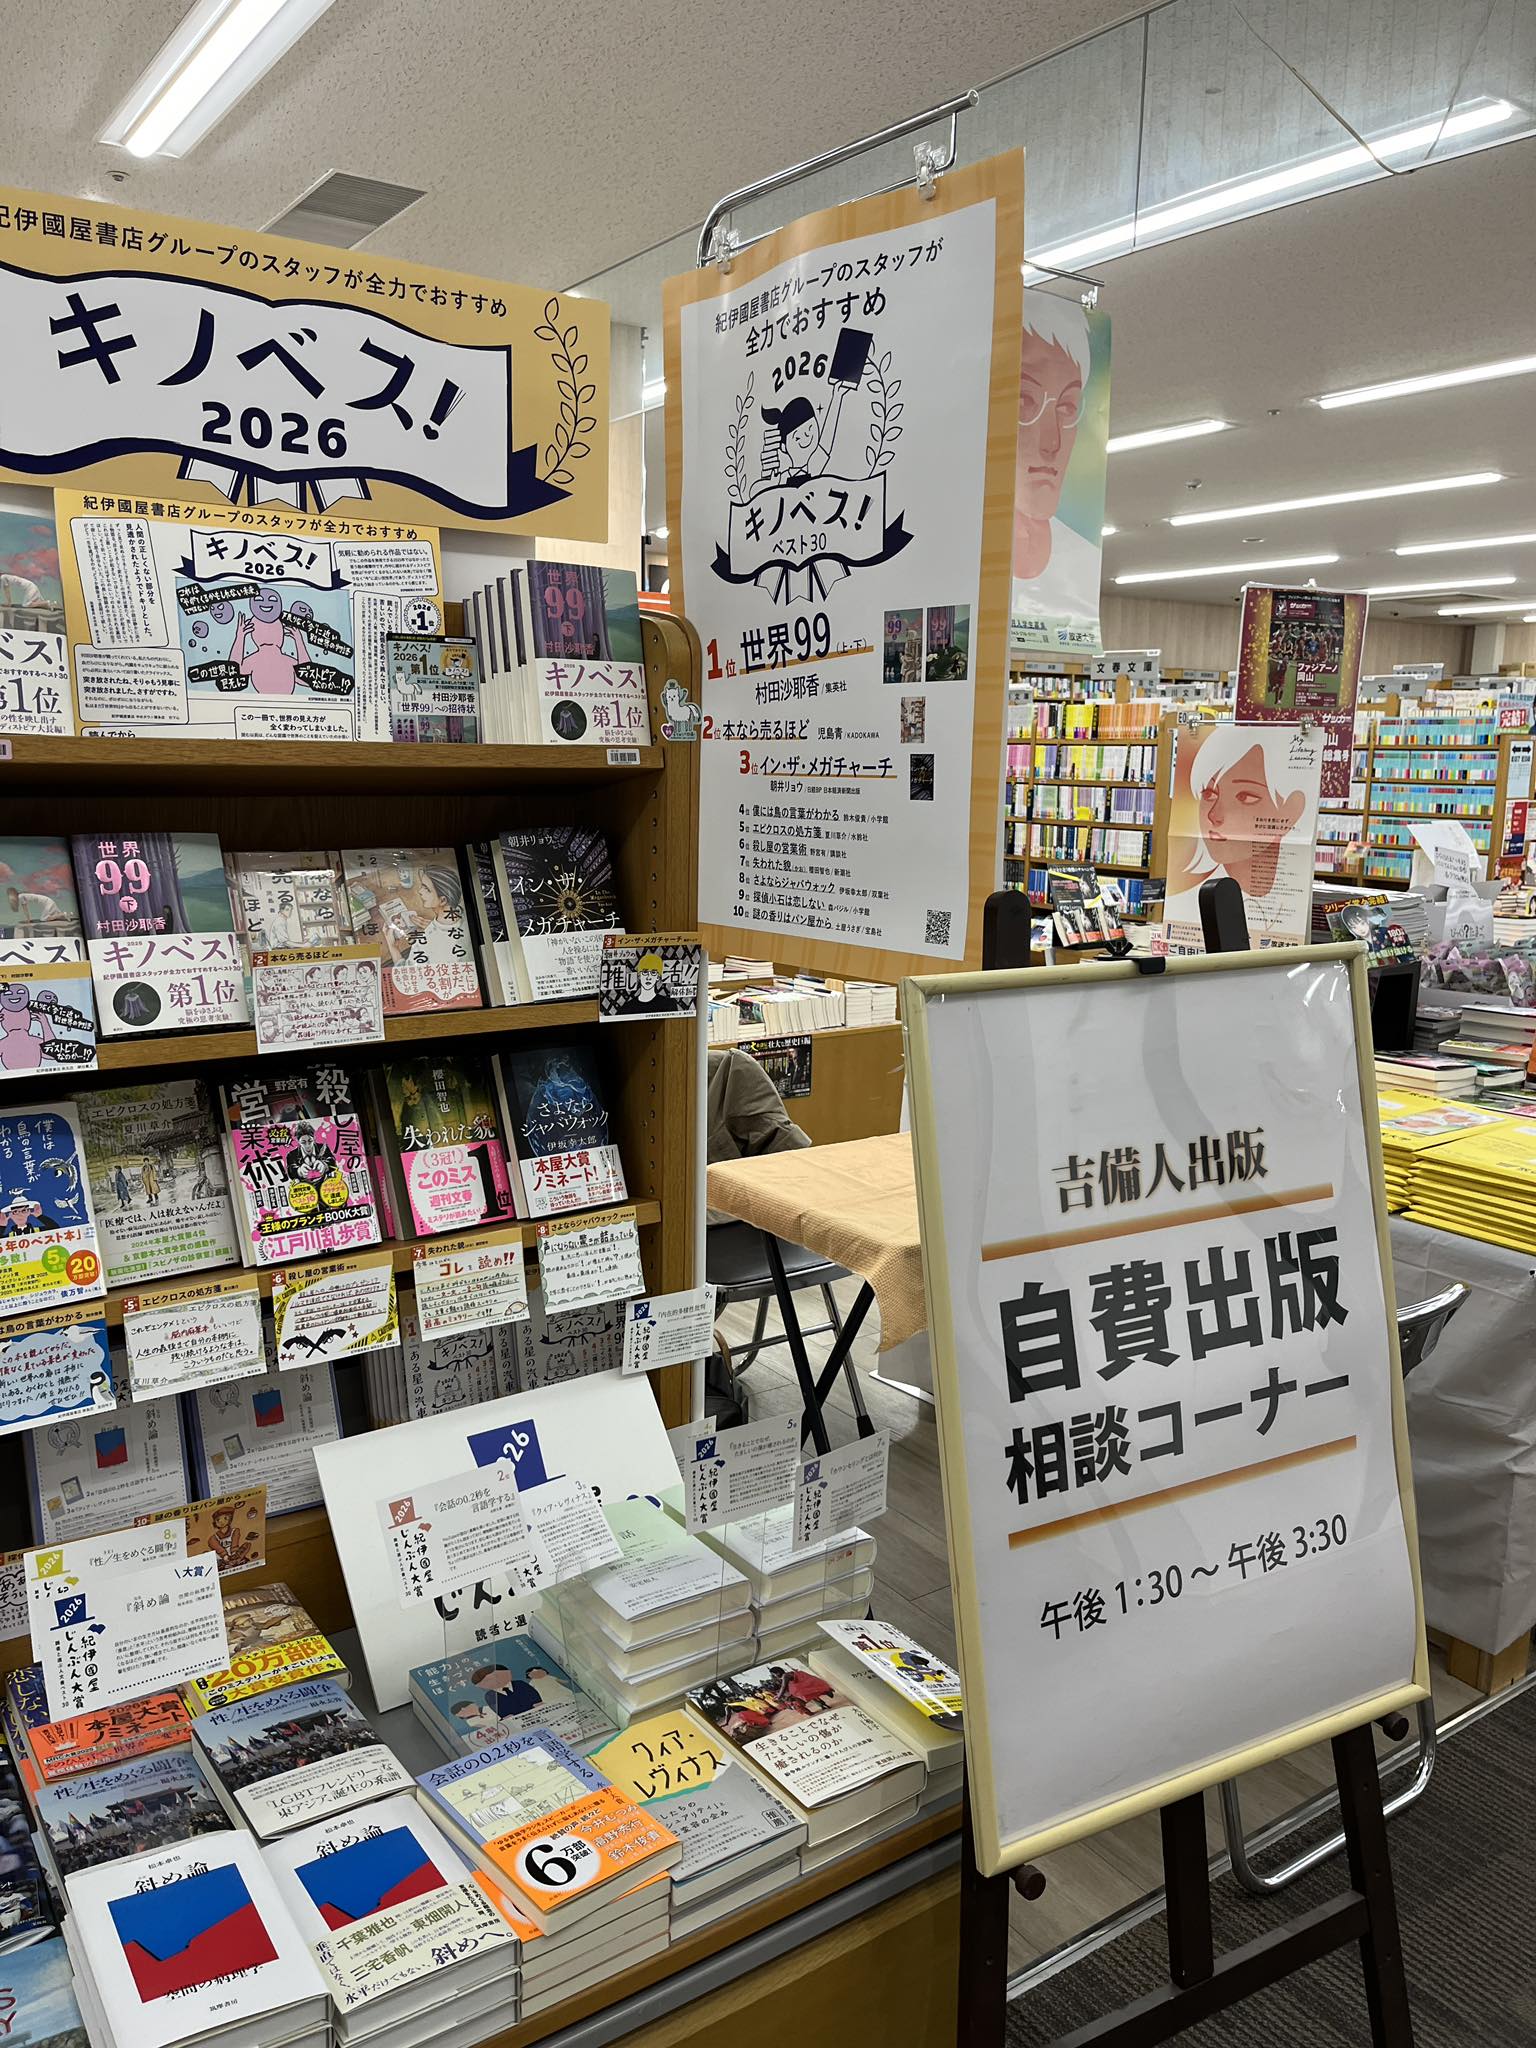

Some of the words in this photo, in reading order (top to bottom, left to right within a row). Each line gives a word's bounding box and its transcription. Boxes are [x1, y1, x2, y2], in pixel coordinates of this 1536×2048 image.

[715, 238, 944, 334] 紀伊國屋書店グループのスタッフが
[745, 286, 886, 358] 全力でおすすめ
[772, 350, 828, 392] 2026
[201, 401, 347, 458] 2026
[83, 495, 418, 540] 紀伊國屋書店グループのスタッフが全力でおすすめ
[772, 532, 827, 555] ベスト30
[244, 561, 285, 576] 2026
[547, 569, 581, 586] 世界
[543, 588, 586, 620] 99
[393, 653, 418, 662] 2026
[740, 612, 832, 673] 世界99
[755, 673, 819, 705] 村田沙耶香
[592, 701, 644, 730] 第1位
[703, 716, 721, 739] 2位
[722, 719, 810, 741] 本なら売るほど
[818, 727, 843, 740] 児島青
[739, 750, 759, 775] 3位
[760, 755, 893, 777] イン・ザ・メガチャーチ
[752, 805, 839, 821] 僕には鳥の言葉がわかる
[753, 824, 822, 839] エピクロスの処方箋
[98, 841, 140, 858] 世界
[752, 840, 807, 856] 殺し屋の営業術
[95, 859, 151, 895] 99
[753, 875, 835, 894] さよならジャバウォック
[753, 891, 825, 910] 探偵小石は恋しない
[96, 917, 167, 932] 村田沙耶香
[521, 912, 621, 938] メガチャーチ
[753, 908, 832, 929] 謎の香りはパン屋から
[103, 934, 238, 971] キノベス!
[271, 951, 329, 962] 本なら売るほど
[168, 975, 239, 1009] 第1位
[437, 965, 452, 999] 役割が
[462, 963, 475, 991] 本には
[316, 1069, 361, 1170] 殺し屋の
[537, 1097, 594, 1116] さよなら
[231, 1080, 287, 1190] 営業術
[521, 1111, 609, 1138] ジャバウォック
[547, 1135, 597, 1151] 伊坂幸太郎
[417, 1165, 477, 1189] このミス
[535, 1151, 591, 1174] 本屋大賞
[1052, 1127, 1268, 1214] 吉備人出版
[551, 1213, 618, 1231] さよならジャバウォック
[268, 1221, 373, 1258] 江戸川乱歩賞
[288, 1264, 344, 1280] 殺し屋の営業術
[998, 1225, 1349, 1402] 自費出版
[698, 1439, 715, 1459] 2026
[1005, 1367, 1350, 1504] 相談コーナー
[395, 1500, 411, 1523] 2026
[40, 1554, 59, 1575] 2026
[401, 1529, 424, 1598] じんぶん大賞
[1039, 1586, 1107, 1640] 午後
[1113, 1560, 1183, 1615] 1:30
[1227, 1535, 1288, 1582] 午後
[1294, 1512, 1349, 1561] 3:30
[60, 1598, 82, 1623] 2026
[65, 1631, 84, 1709] じんぶん大賞
[85, 1700, 181, 1731] 本屋大賞
[93, 1713, 184, 1743] ノミネート
[755, 1712, 846, 1752] 生きることでなぜ、
[764, 1724, 843, 1761] たましいの傷が
[774, 1738, 843, 1771] 癒されるのか
[633, 1750, 727, 1799] レヴィナス
[580, 1804, 639, 1834] 今井むつみ
[560, 1840, 587, 1857] 万部
[525, 1844, 577, 1886] 6
[410, 1899, 470, 1932] 東畑開人
[337, 1915, 398, 1950] 千葉雅也
[350, 1942, 414, 1982] 三宅香帆
[432, 1931, 513, 1967] 斜めへ。
